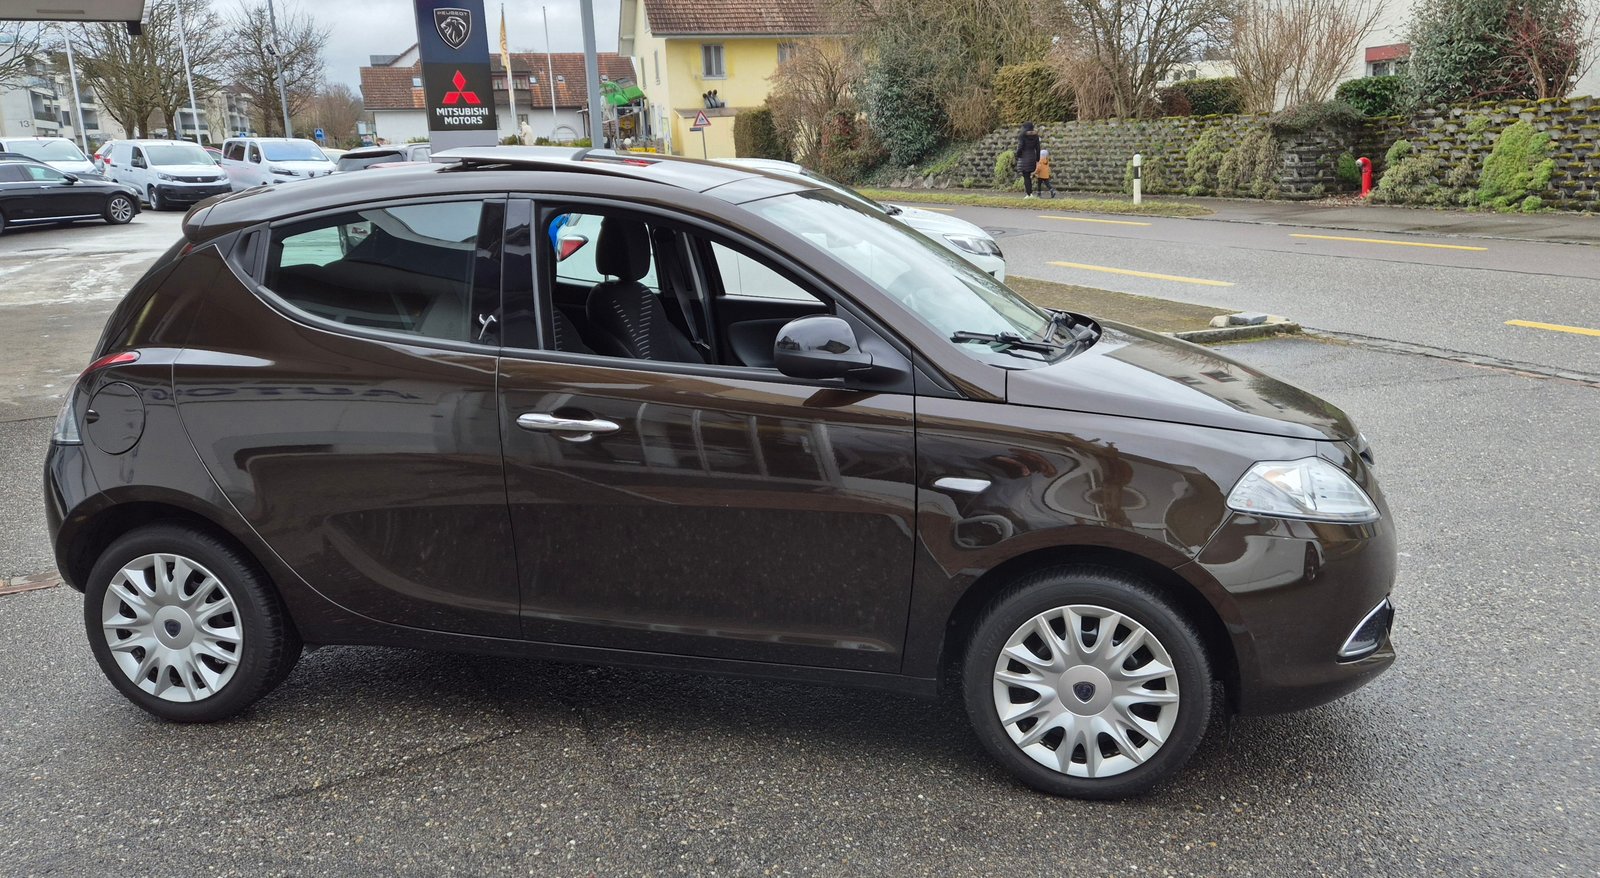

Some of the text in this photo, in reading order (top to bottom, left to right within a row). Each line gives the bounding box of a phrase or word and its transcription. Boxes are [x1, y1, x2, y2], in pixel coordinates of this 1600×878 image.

[436, 107, 489, 116] MITSUBISHI
[19, 120, 30, 128] 13
[444, 116, 483, 125] MOTORS
